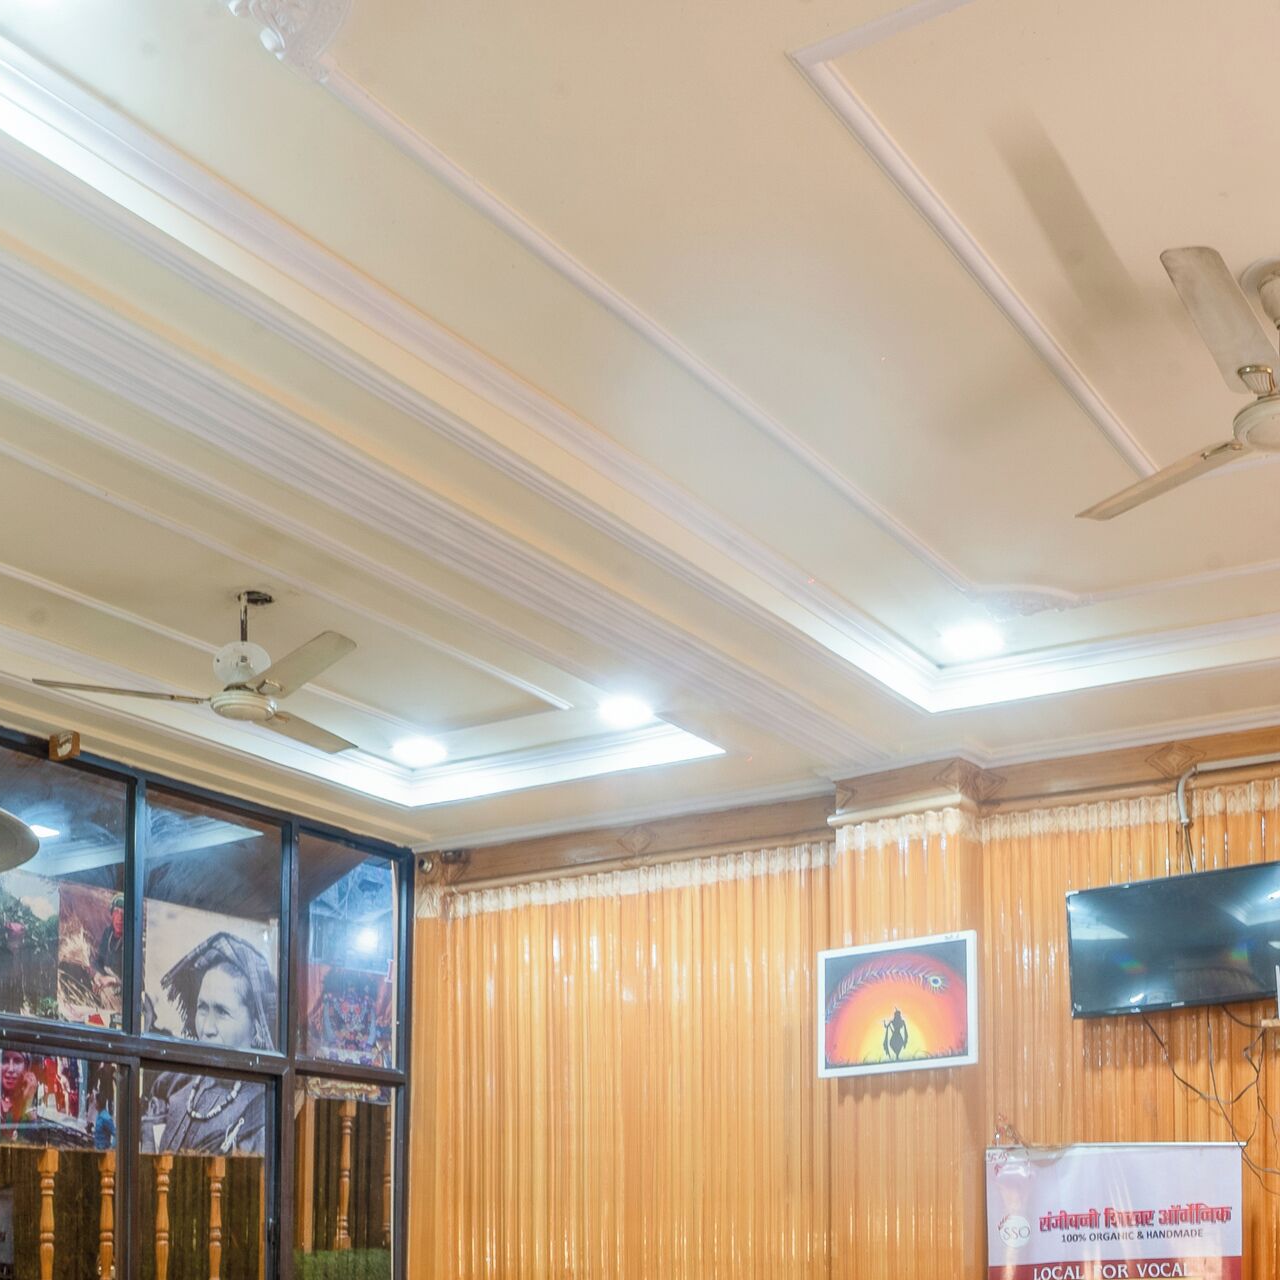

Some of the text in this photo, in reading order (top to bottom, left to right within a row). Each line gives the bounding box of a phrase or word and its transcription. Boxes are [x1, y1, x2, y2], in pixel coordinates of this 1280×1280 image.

[1039, 1208, 1101, 1232] संजीवनी
[1061, 1228, 1204, 1243] 100% ORGANIC & HANDMADE
[1093, 1264, 1129, 1280] FOR
[1136, 1262, 1193, 1279] VOCAL
